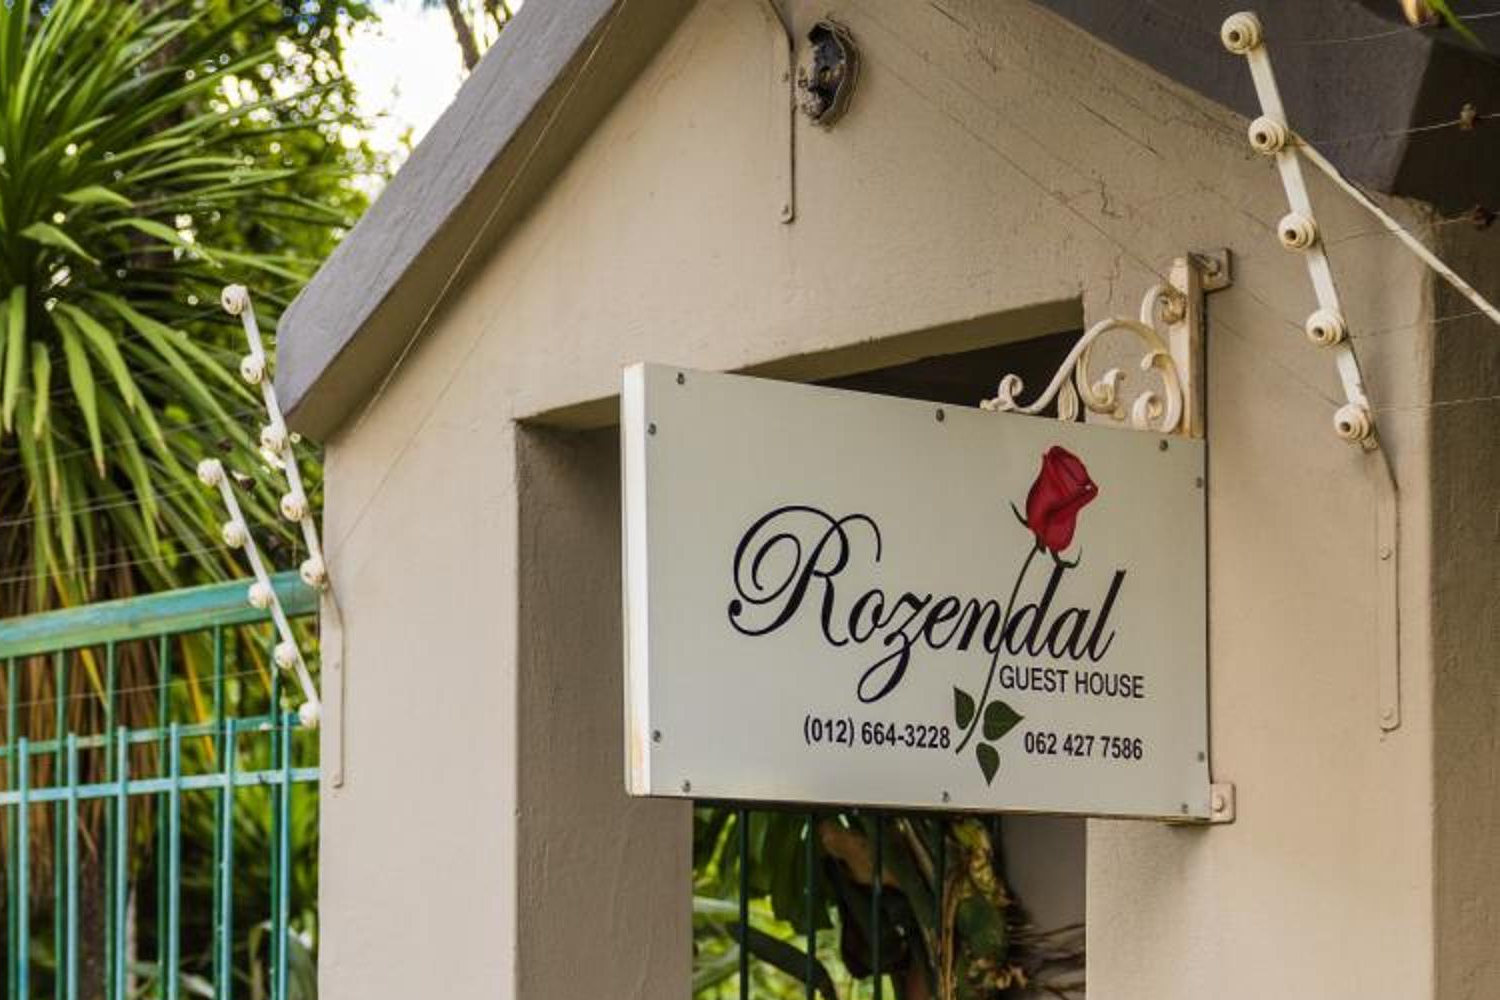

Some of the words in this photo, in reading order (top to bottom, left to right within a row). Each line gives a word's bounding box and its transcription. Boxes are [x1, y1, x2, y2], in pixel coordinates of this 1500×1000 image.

[728, 505, 1127, 704] Rozendal
[999, 665, 1069, 694] GUEST
[1075, 671, 1146, 699] HOUSE
[803, 713, 855, 747] (012)
[861, 721, 951, 750] 664-3228
[1024, 731, 1057, 755] 062
[1063, 734, 1095, 757] 427
[1101, 736, 1144, 760] 7586
